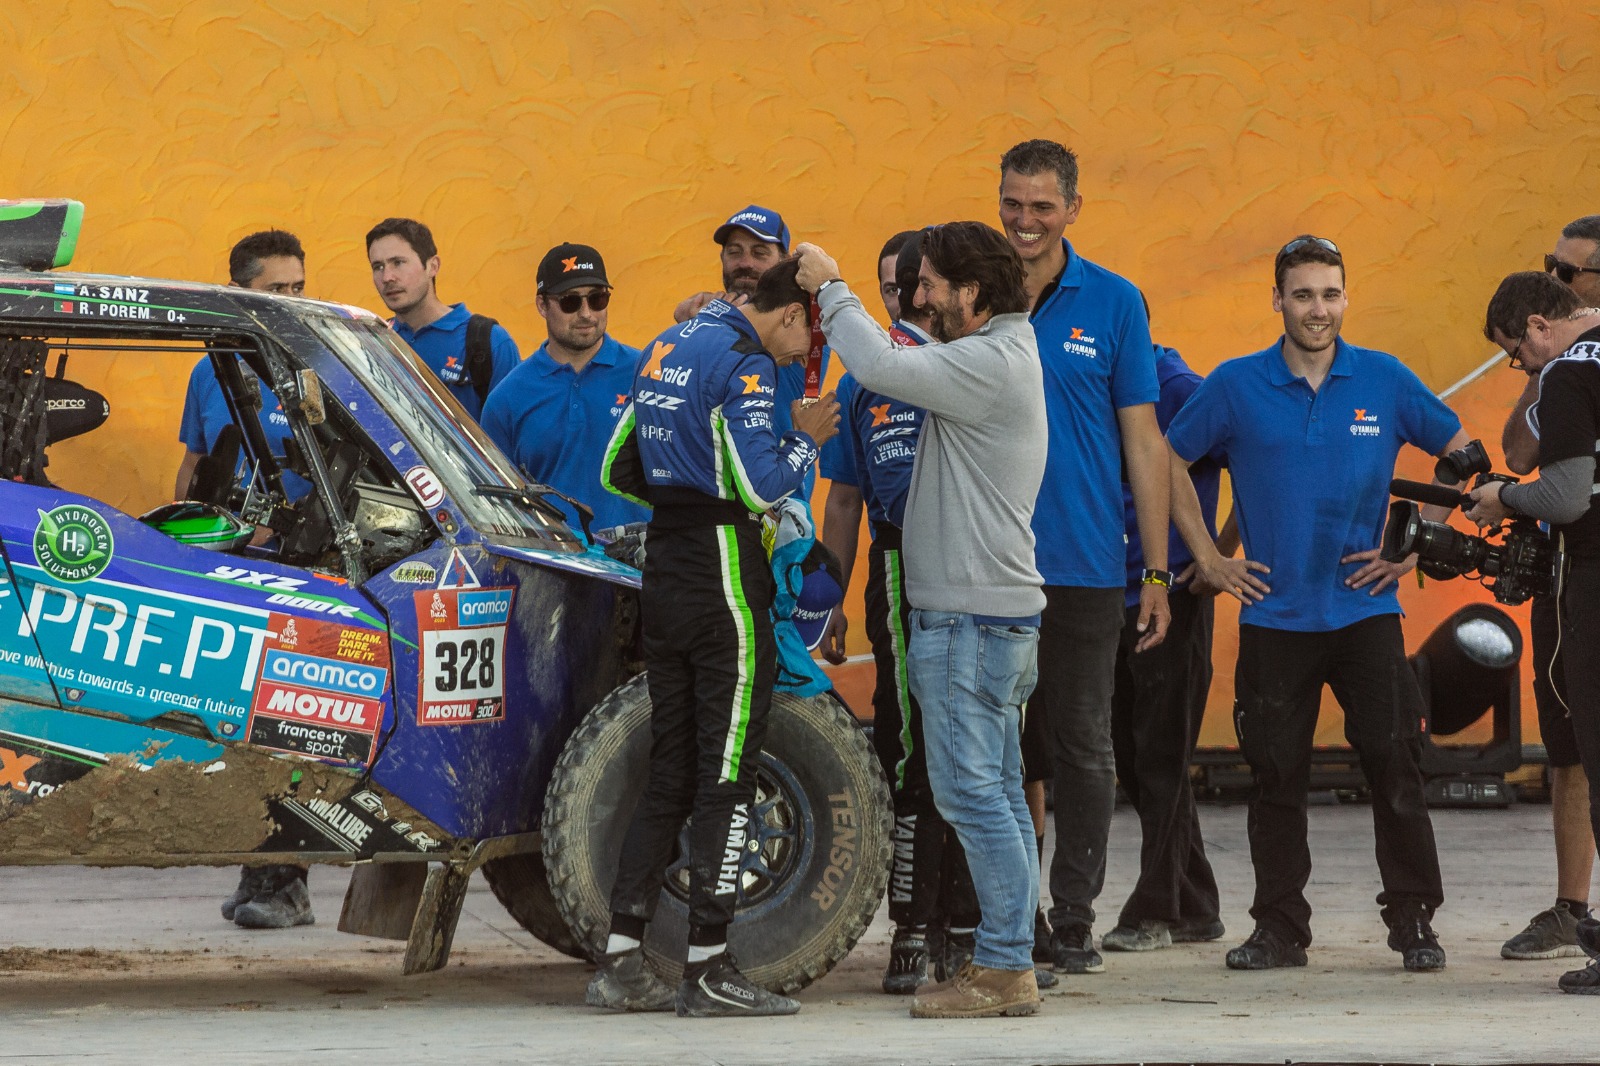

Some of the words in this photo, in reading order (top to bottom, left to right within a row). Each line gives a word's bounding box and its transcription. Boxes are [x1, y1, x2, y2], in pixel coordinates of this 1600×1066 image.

[100, 286, 149, 303] SANZ
[79, 302, 94, 316] R.
[99, 303, 150, 320] POREM
[1071, 343, 1097, 357] YAMAHA
[44, 398, 86, 411] parco
[868, 403, 915, 428] X-raid
[1358, 425, 1380, 434] YAMAHA
[876, 440, 904, 453] VISITE
[410, 471, 439, 502] E
[55, 510, 108, 550] HYDROGEN
[38, 543, 97, 579] SOLUTIONS
[462, 600, 508, 616] aramco
[18, 583, 278, 692] PRF.PT
[338, 638, 371, 652] DARE.
[340, 629, 381, 645] DREAM.
[337, 648, 363, 660] LIVE
[363, 651, 375, 662] IT.
[434, 636, 495, 692] 328
[272, 657, 377, 691] aramco
[58, 666, 75, 681] us
[78, 669, 134, 696] towards
[136, 686, 146, 697] a
[150, 688, 203, 710] greener
[205, 696, 246, 719] future
[266, 689, 366, 725] MOTUL
[426, 703, 472, 719] MOTUL
[305, 740, 344, 757] sport
[715, 803, 748, 896] YAMAHA
[810, 786, 858, 912] TENSOR
[892, 814, 917, 903] YAMAHA
